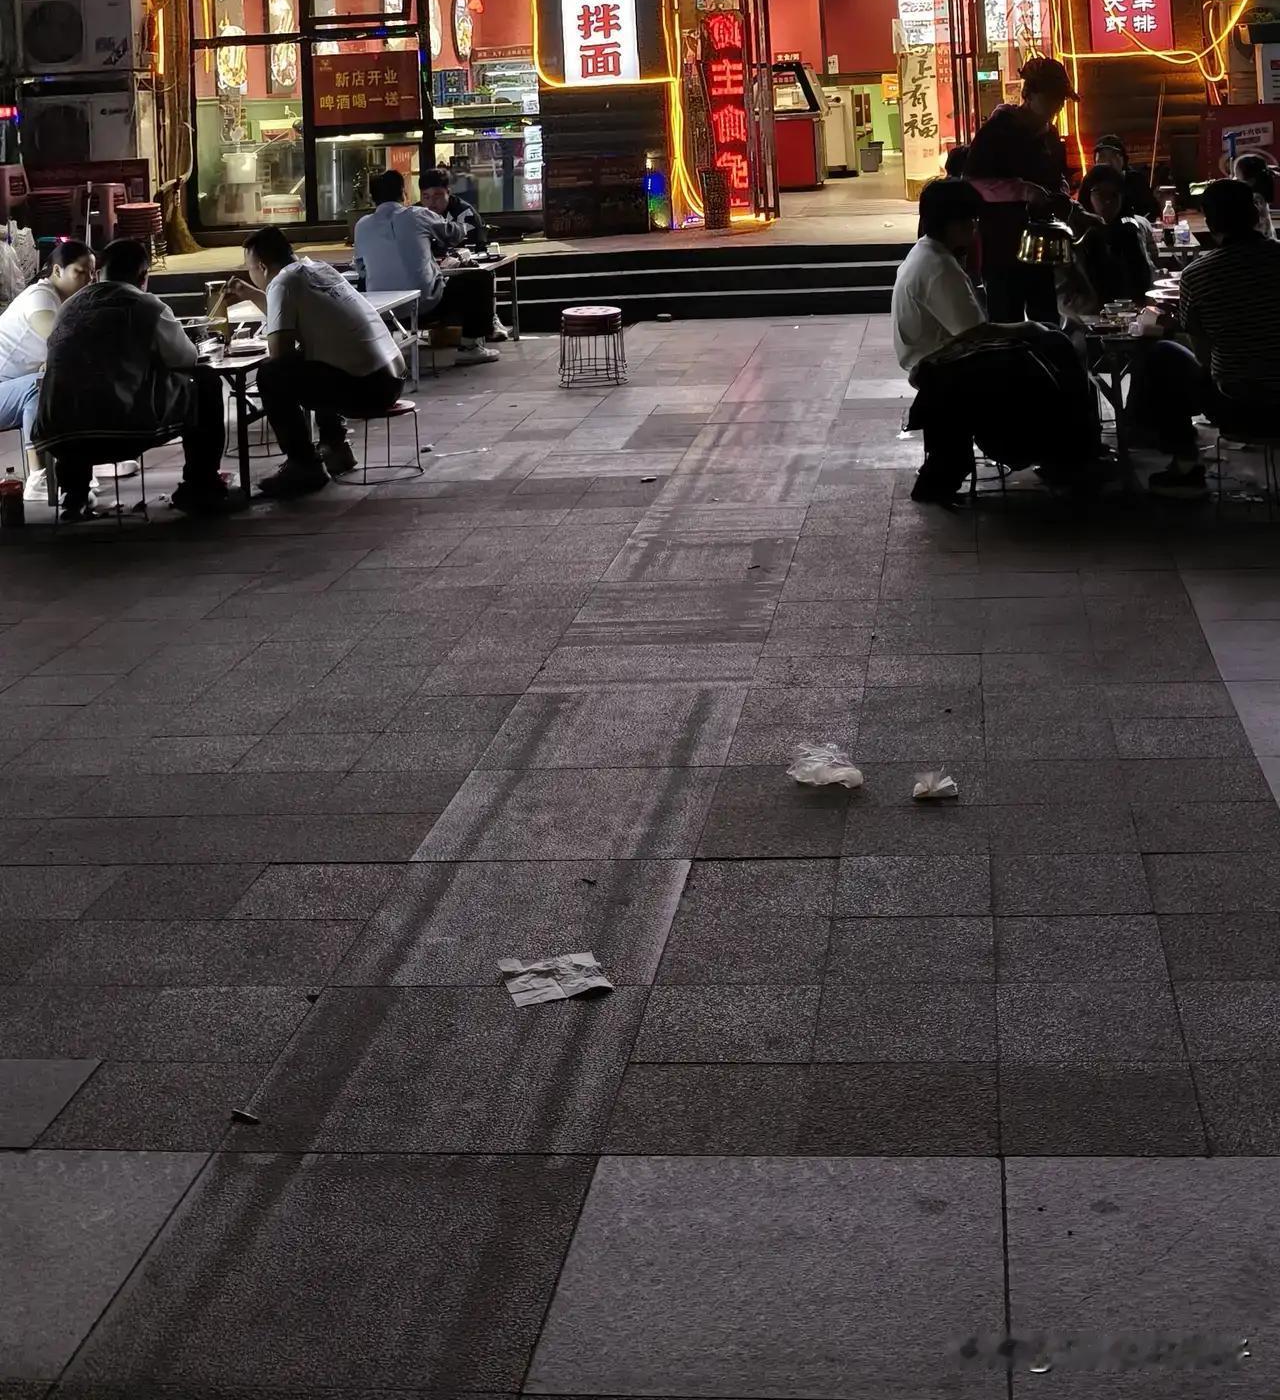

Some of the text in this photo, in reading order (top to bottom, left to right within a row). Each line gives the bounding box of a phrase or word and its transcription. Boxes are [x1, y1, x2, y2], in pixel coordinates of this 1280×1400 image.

[335, 66, 399, 88] 新店开业
[319, 90, 415, 111] 啤酒喝一送一
